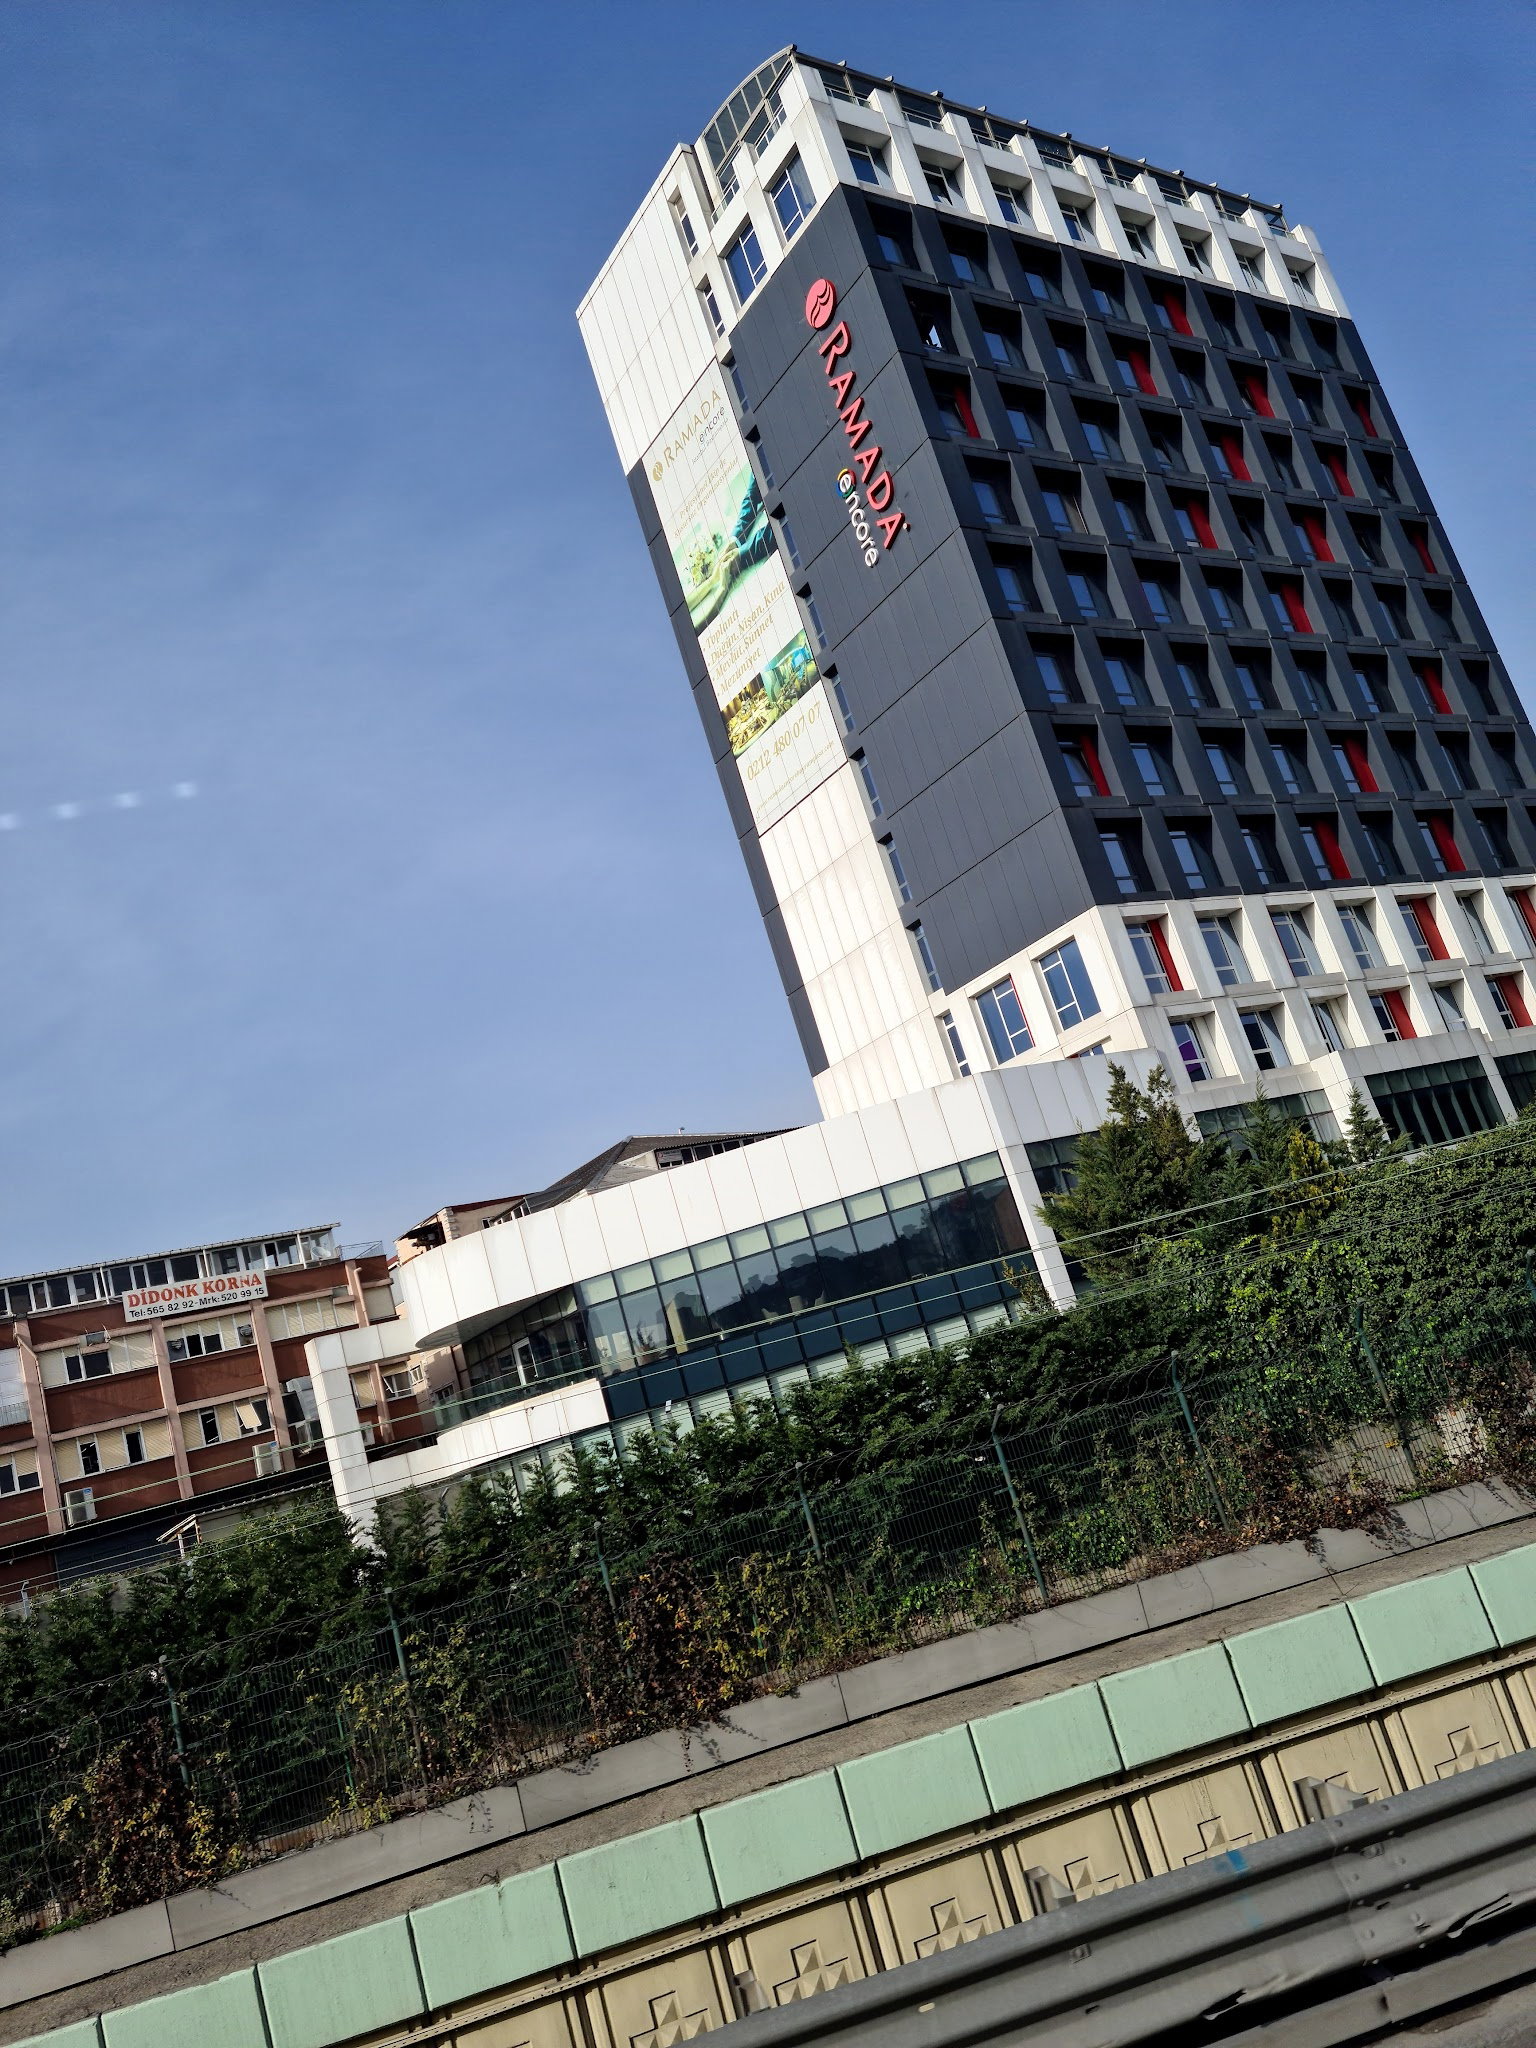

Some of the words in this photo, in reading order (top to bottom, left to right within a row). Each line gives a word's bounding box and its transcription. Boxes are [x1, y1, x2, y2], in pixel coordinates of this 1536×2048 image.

[663, 390, 721, 467] RAMADA
[700, 406, 725, 443] encore
[819, 321, 905, 550] RAMADA
[837, 470, 880, 567] encore
[747, 749, 771, 780] 0212
[773, 730, 791, 757] 480
[793, 714, 805, 738] 07
[808, 701, 820, 724] 07
[127, 1284, 199, 1308] DİDONK
[202, 1273, 262, 1295] KORNA
[168, 1302, 179, 1312] 82
[240, 1290, 252, 1299] 99
[254, 1287, 265, 1296] 15
